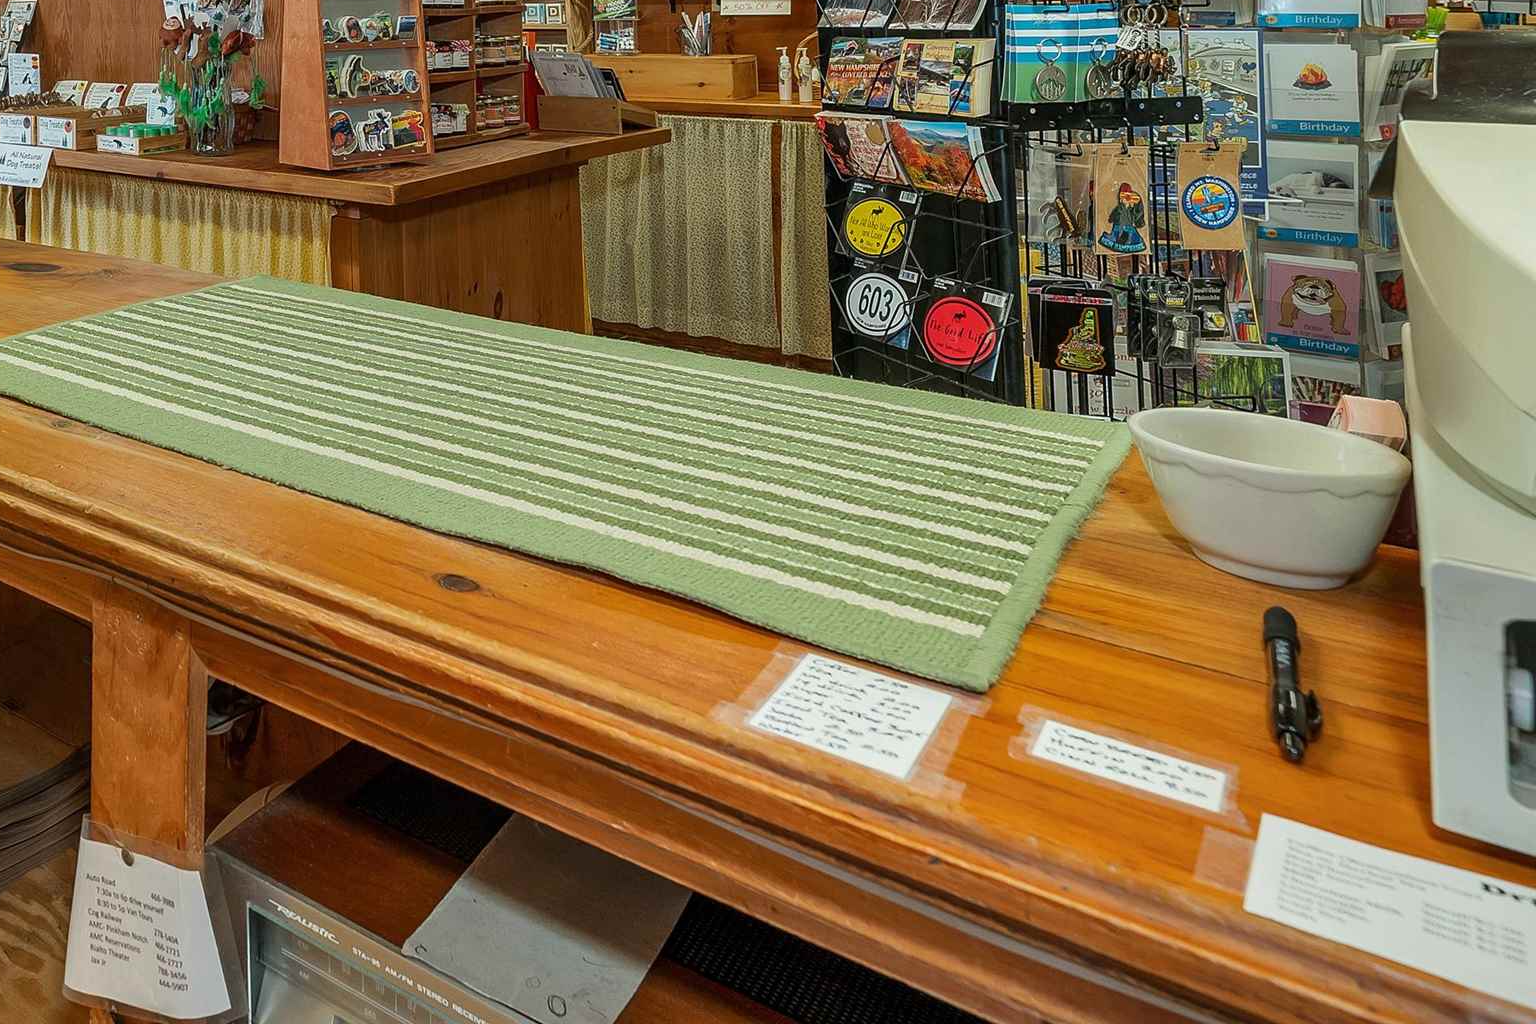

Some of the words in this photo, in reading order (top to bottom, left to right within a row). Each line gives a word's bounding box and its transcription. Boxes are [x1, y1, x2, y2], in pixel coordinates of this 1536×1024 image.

[550, 7, 558, 15] D
[1295, 14, 1343, 25] Birthday
[1299, 122, 1351, 133] Birthday
[19, 151, 43, 161] Natural
[6, 160, 18, 170] Dog
[1295, 231, 1344, 244] Birthday
[859, 283, 893, 322] 603
[1299, 338, 1351, 353] Birthday
[86, 874, 100, 883] Auto
[102, 876, 116, 887] Road
[101, 911, 122, 925] Railway
[268, 898, 340, 944] REALISTIC
[385, 965, 414, 986] AM/FM
[417, 983, 449, 1007] STEREO
